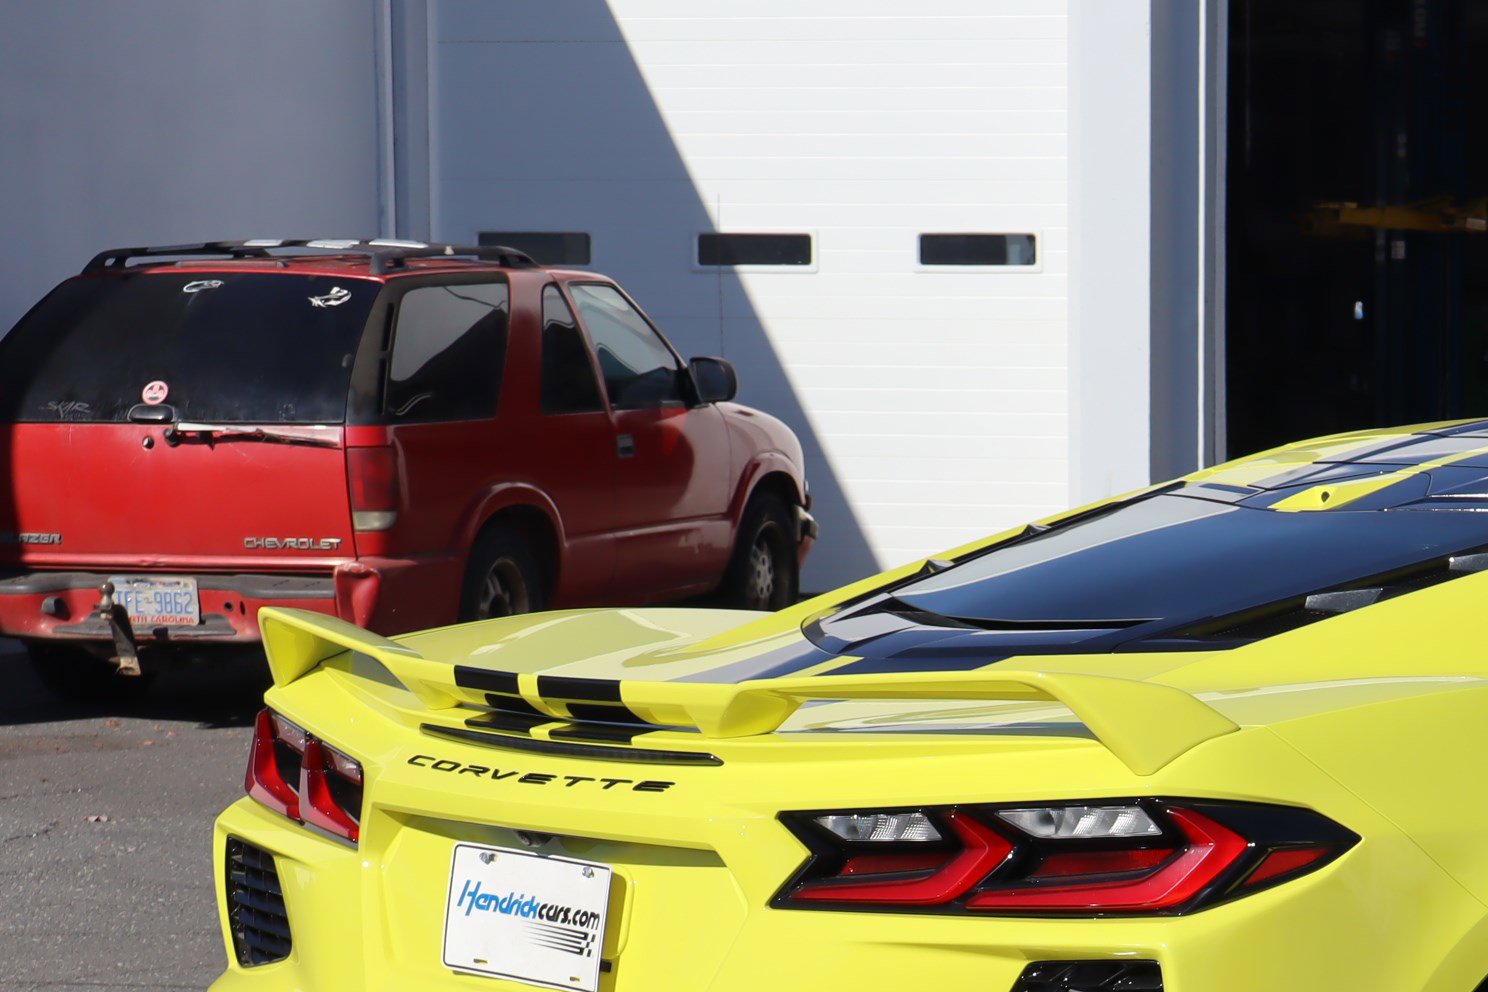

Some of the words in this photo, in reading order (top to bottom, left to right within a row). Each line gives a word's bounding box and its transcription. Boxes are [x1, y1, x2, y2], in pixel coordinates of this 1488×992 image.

[0, 532, 63, 545] AZER
[243, 537, 342, 550] CHEVROLET
[128, 614, 148, 624] RTH
[151, 614, 195, 625] CAROLINA
[407, 754, 676, 793] CORVETTE
[457, 879, 601, 931] Hendrickcars.com
